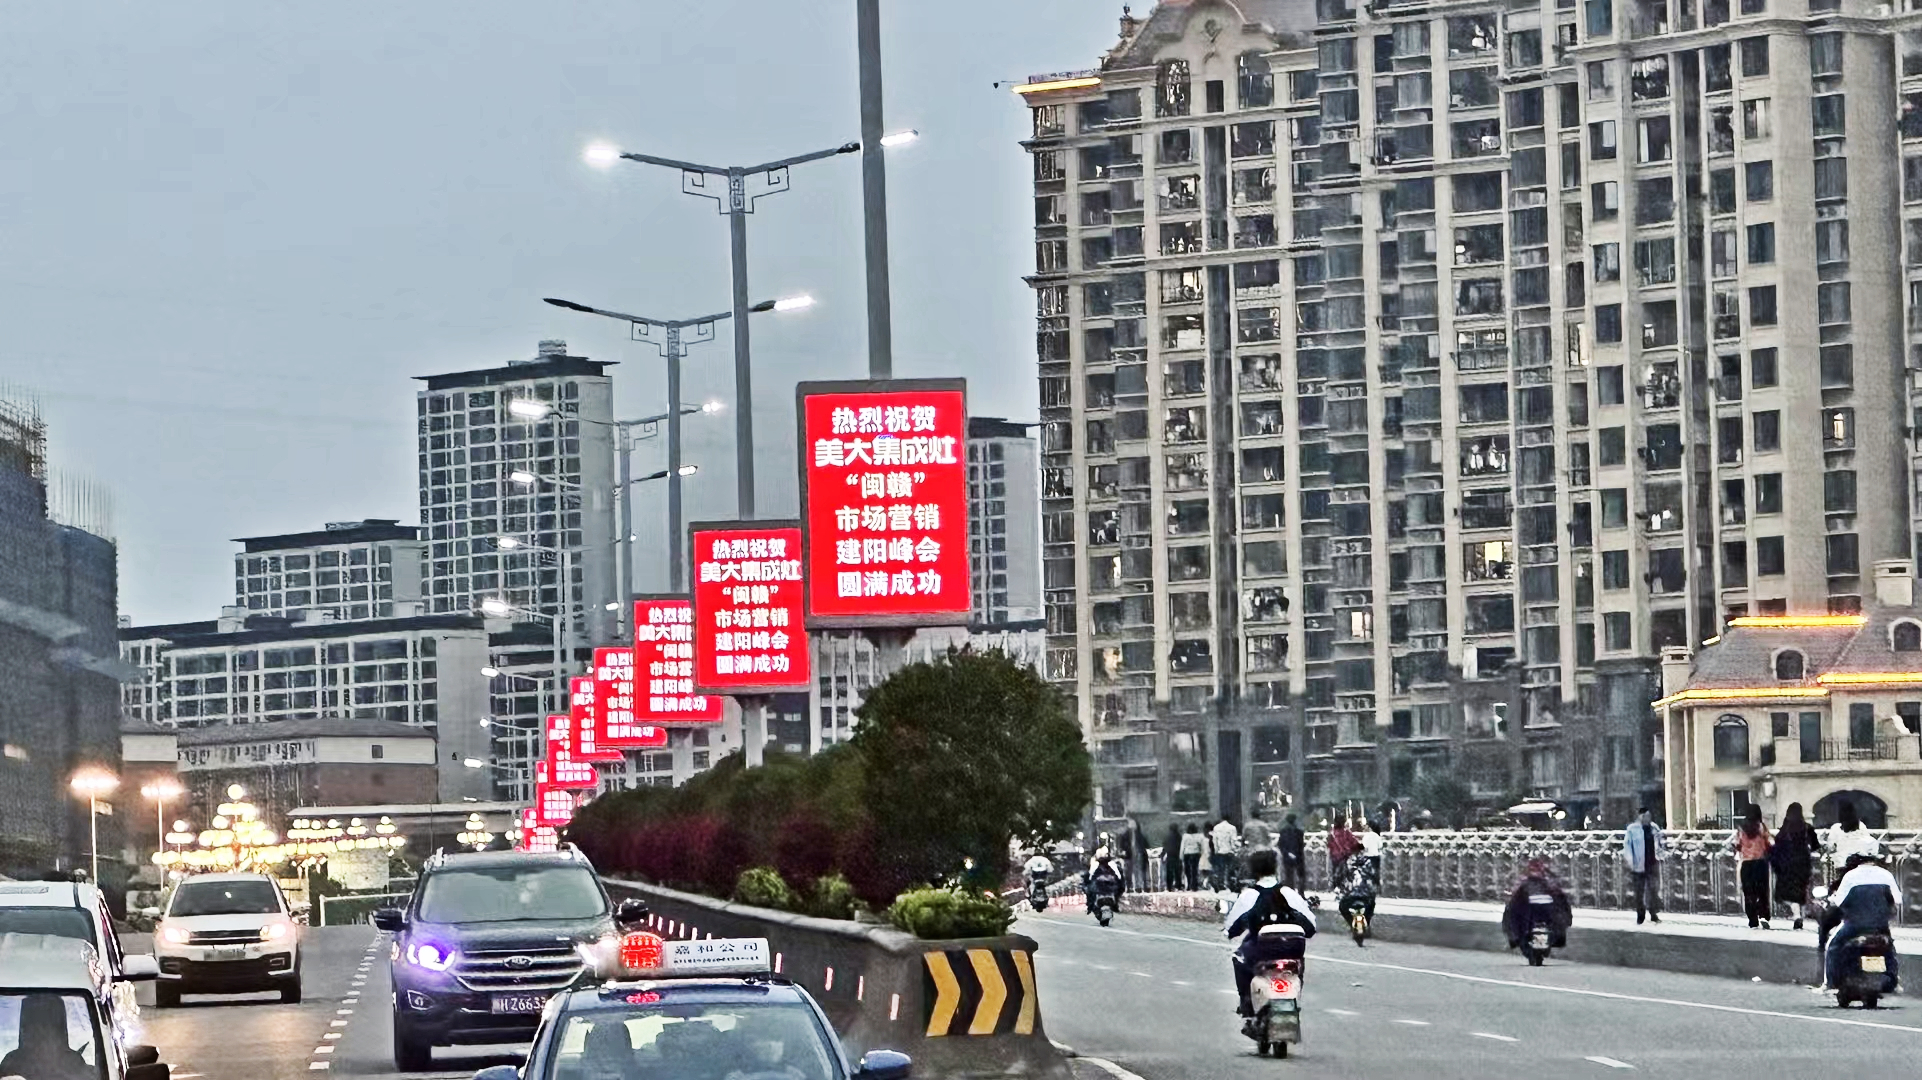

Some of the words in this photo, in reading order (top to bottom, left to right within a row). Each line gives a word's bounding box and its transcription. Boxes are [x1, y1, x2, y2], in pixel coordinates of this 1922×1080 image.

[831, 405, 936, 434] 热烈祝贺
[814, 435, 957, 467] 美大集成灶
[845, 471, 926, 499] “闽赣”
[835, 503, 940, 533] 市场营销
[712, 538, 787, 560] 热烈祝贺
[835, 535, 941, 565] 建阳峰会
[700, 559, 803, 583] 美大集成灶
[837, 568, 942, 598] 圆满成功
[715, 607, 789, 629] 市场营销
[715, 630, 790, 652] 建阳峰会
[716, 653, 790, 675] 圆满成功
